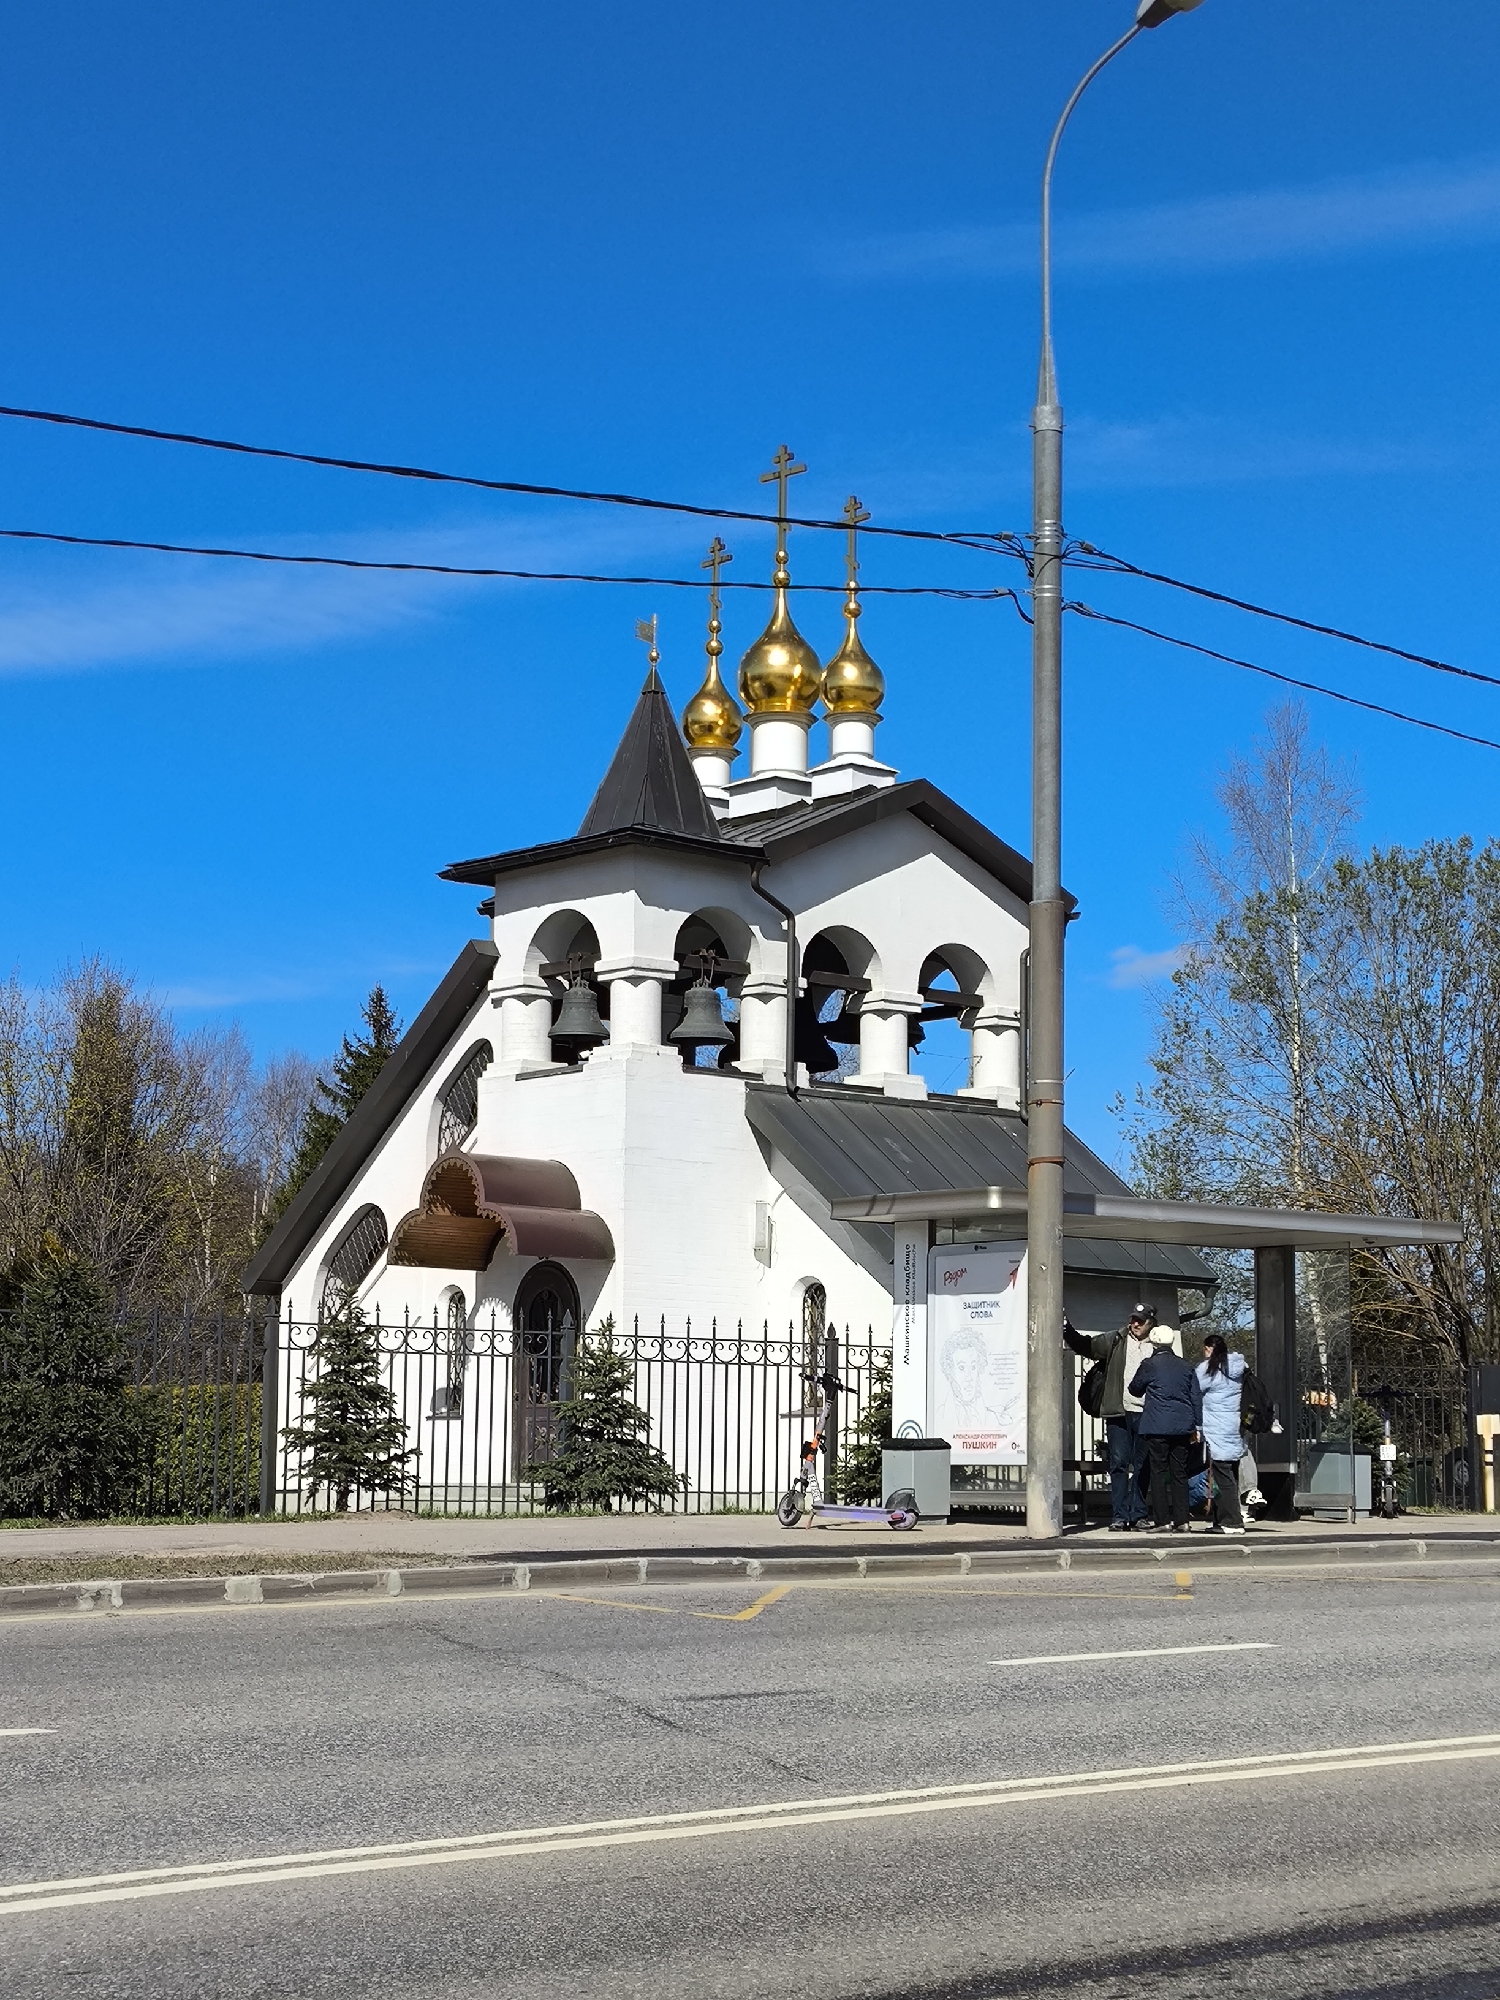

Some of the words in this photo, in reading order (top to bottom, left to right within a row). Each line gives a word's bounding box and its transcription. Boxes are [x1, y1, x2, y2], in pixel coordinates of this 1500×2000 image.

[903, 1243, 911, 1296] кладбище
[943, 1267, 968, 1288] Рядом
[962, 1300, 1001, 1310] ЗАЩИТНИК
[970, 1311, 994, 1319] СЛОВА
[903, 1299, 911, 1366] Машкинское
[962, 1441, 997, 1450] ПУШКИН
